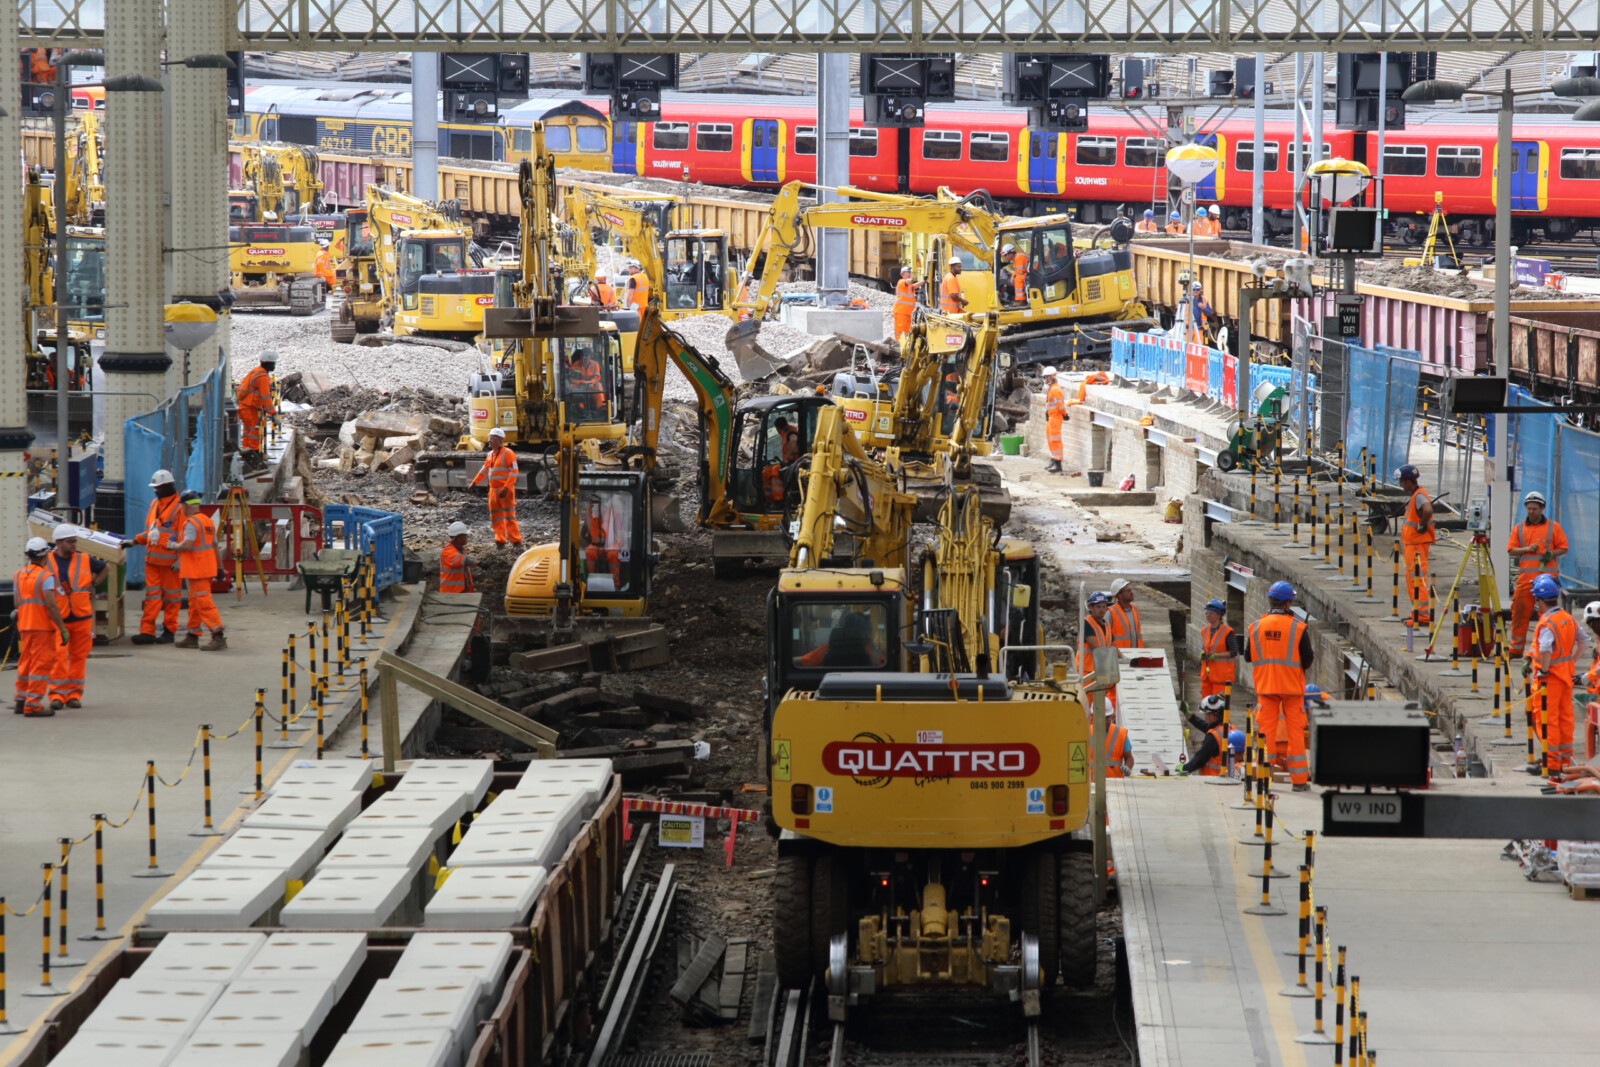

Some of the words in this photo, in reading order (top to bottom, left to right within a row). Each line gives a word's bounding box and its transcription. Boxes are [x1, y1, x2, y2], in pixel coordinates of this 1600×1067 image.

[1183, 115, 1197, 135] 15
[371, 125, 413, 155] GBR
[652, 160, 668, 168] SOUTH
[1074, 176, 1092, 185] SOUTH
[1093, 177, 1107, 186] WEST
[1184, 191, 1192, 200] 15
[854, 216, 904, 226] QUATTRO
[1343, 325, 1356, 334] BR
[687, 361, 698, 372] JCB
[917, 732, 928, 743] 10
[838, 748, 1025, 774] QUATTRO
[914, 770, 953, 788] Group
[970, 781, 988, 789] 0845
[991, 781, 1004, 789] 900
[1007, 780, 1025, 789] 2999
[1337, 802, 1362, 814] W9
[1369, 802, 1396, 815] IND
